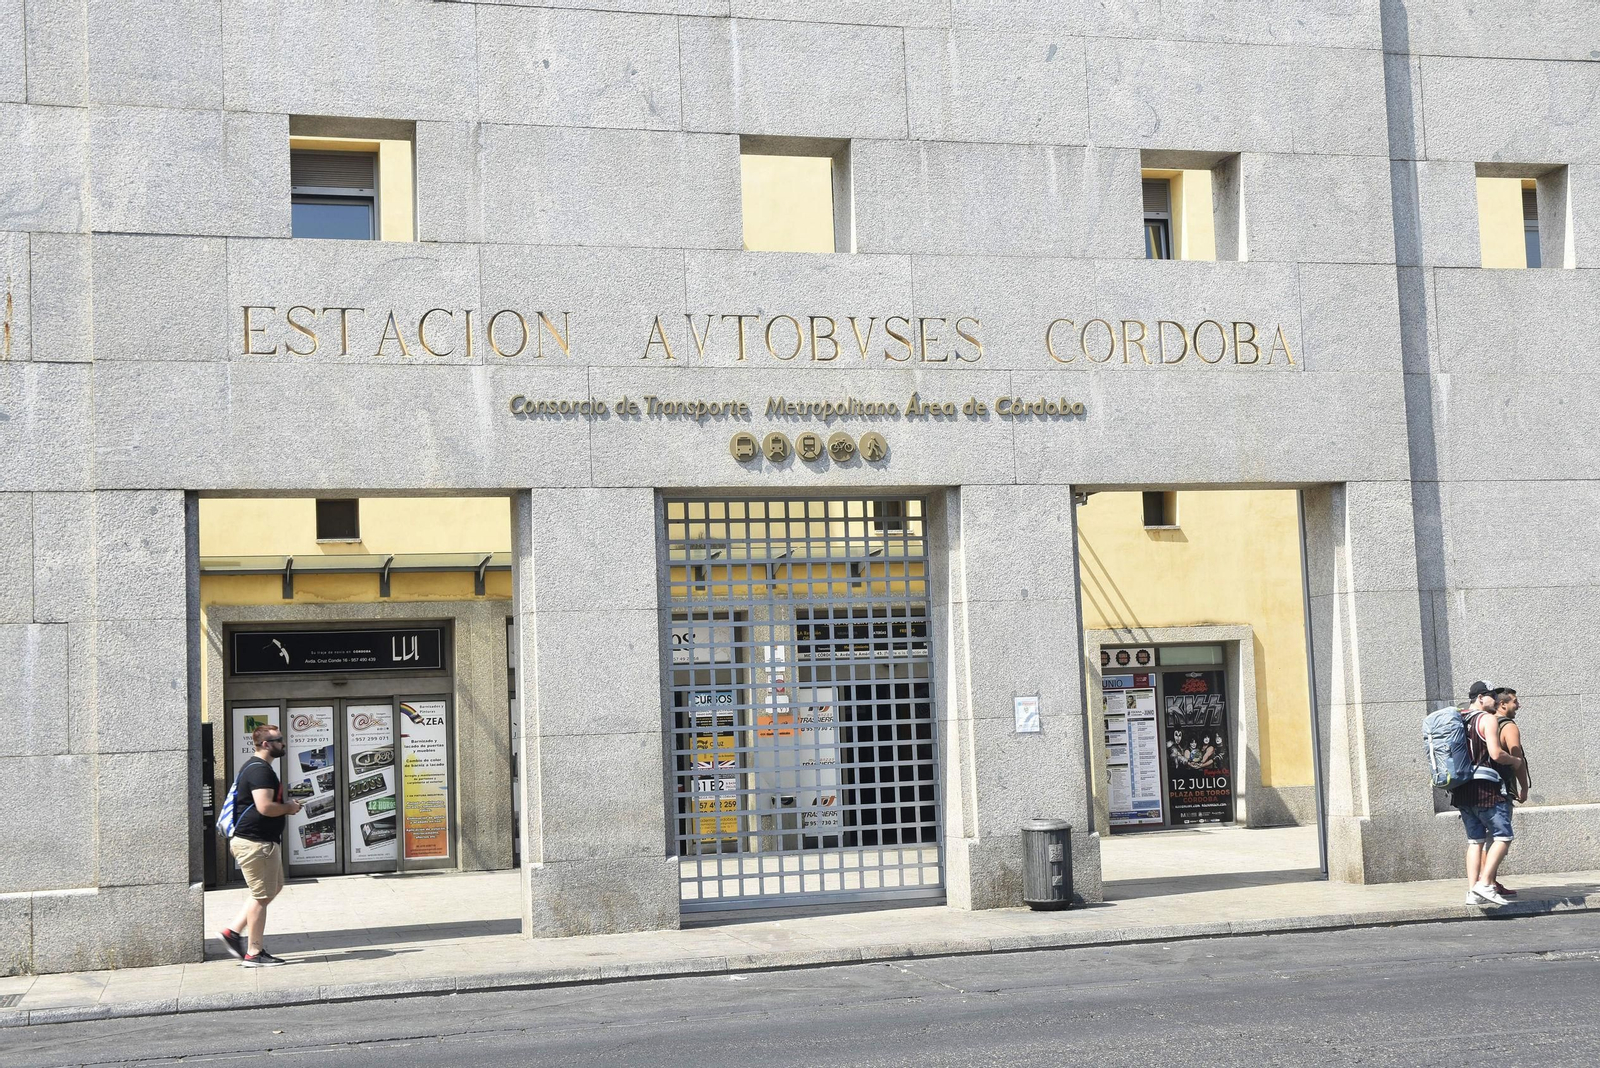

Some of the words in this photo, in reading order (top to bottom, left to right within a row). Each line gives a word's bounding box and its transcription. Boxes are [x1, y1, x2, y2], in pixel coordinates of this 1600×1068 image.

[241, 305, 572, 359] ESTACION
[640, 313, 984, 363] AVTOBVSES
[1045, 318, 1296, 366] CORDOBA
[510, 395, 606, 416] Consorcio
[615, 395, 638, 416] de
[644, 395, 748, 421] Transporte
[765, 396, 897, 420] Metropolitano
[905, 392, 954, 416] Área
[962, 397, 987, 416] de
[995, 396, 1084, 416] Córdoba
[1165, 694, 1225, 728] KISS
[1172, 779, 1185, 790] 12
[1189, 777, 1227, 789] JULIO
[368, 800, 376, 810] 12
